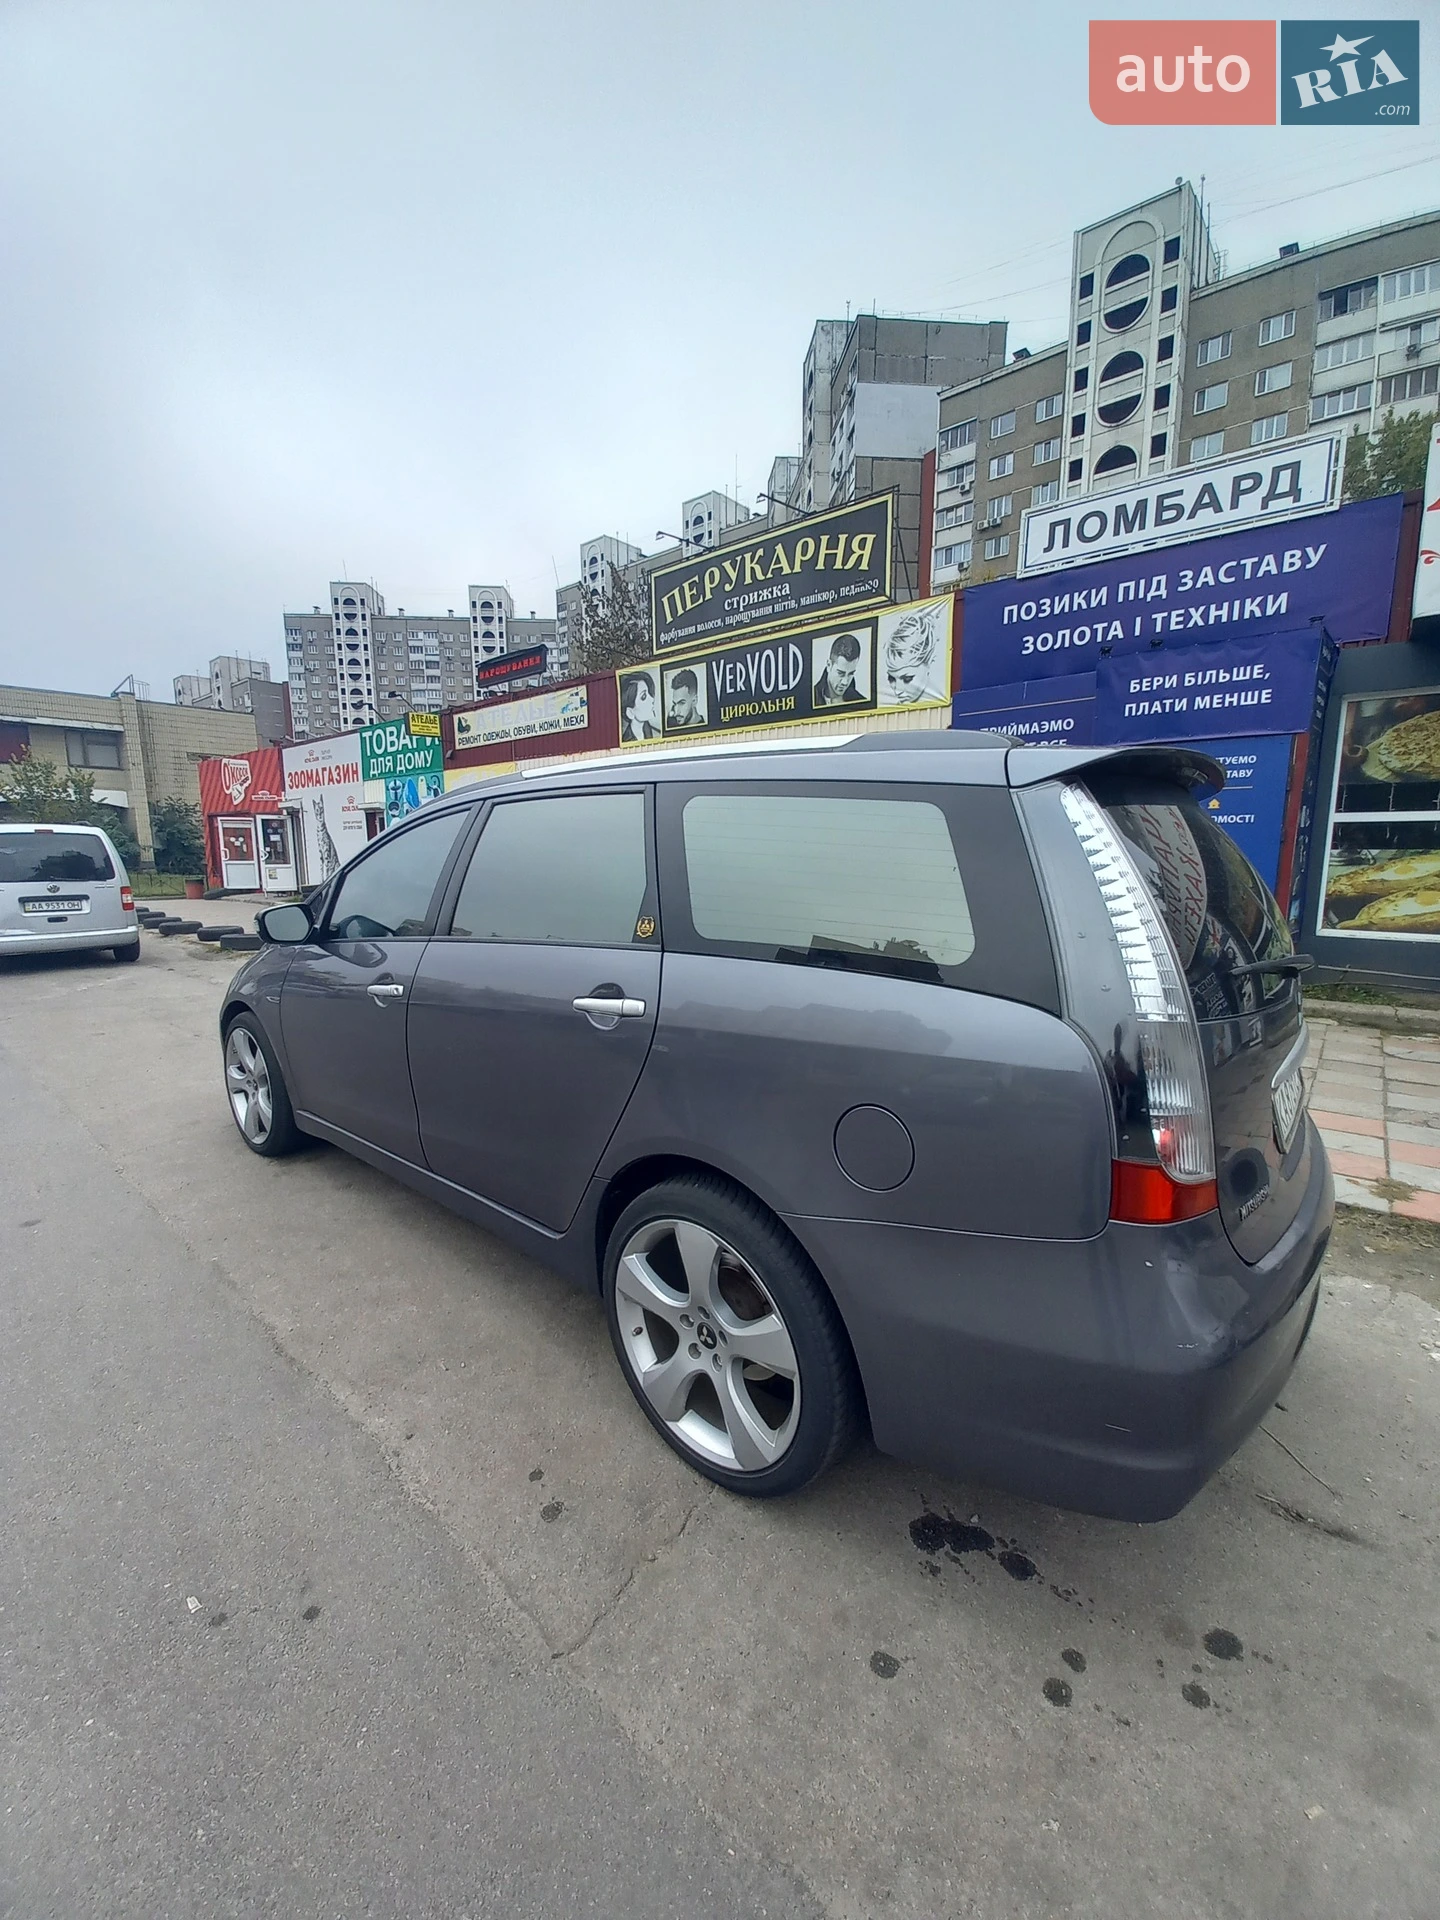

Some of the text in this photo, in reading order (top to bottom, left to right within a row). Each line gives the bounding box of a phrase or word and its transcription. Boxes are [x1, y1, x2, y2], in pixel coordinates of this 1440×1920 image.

[1042, 459, 1302, 554] ЛОМБАРД
[660, 533, 877, 625] ПЕРУКАРНЯ
[1002, 543, 1328, 625] ПОЗИКИ ПІД ЗАСТАВУ
[724, 582, 791, 612] стрижка
[724, 604, 773, 624] нарощування
[774, 596, 798, 613] нігтів,
[800, 588, 838, 607] манікюр,
[1021, 591, 1289, 655] ЗОЛОТА І ТЕХНІКИ
[1129, 663, 1271, 694] БЕРИ БІЛЬШЕ,
[475, 697, 557, 731] АТЕЛЬЕ
[720, 696, 795, 723] ЦИРЮЛЬНЯ
[1124, 689, 1273, 718] ПЛАТИ МЕНШЕ
[410, 713, 438, 726] АТЕЛЬЕ
[457, 714, 585, 747] РЕМОНТ ОДЕЖДЫ, ОБУВИ, КОЖИ, МЕХА
[369, 749, 434, 778] ДЛЯ ДОМУ
[1214, 755, 1257, 765] ТУЄМО
[1226, 769, 1254, 779] ТАВУ
[287, 761, 360, 790] ЗООМАГАЗИН
[45, 902, 65, 910] 9531
